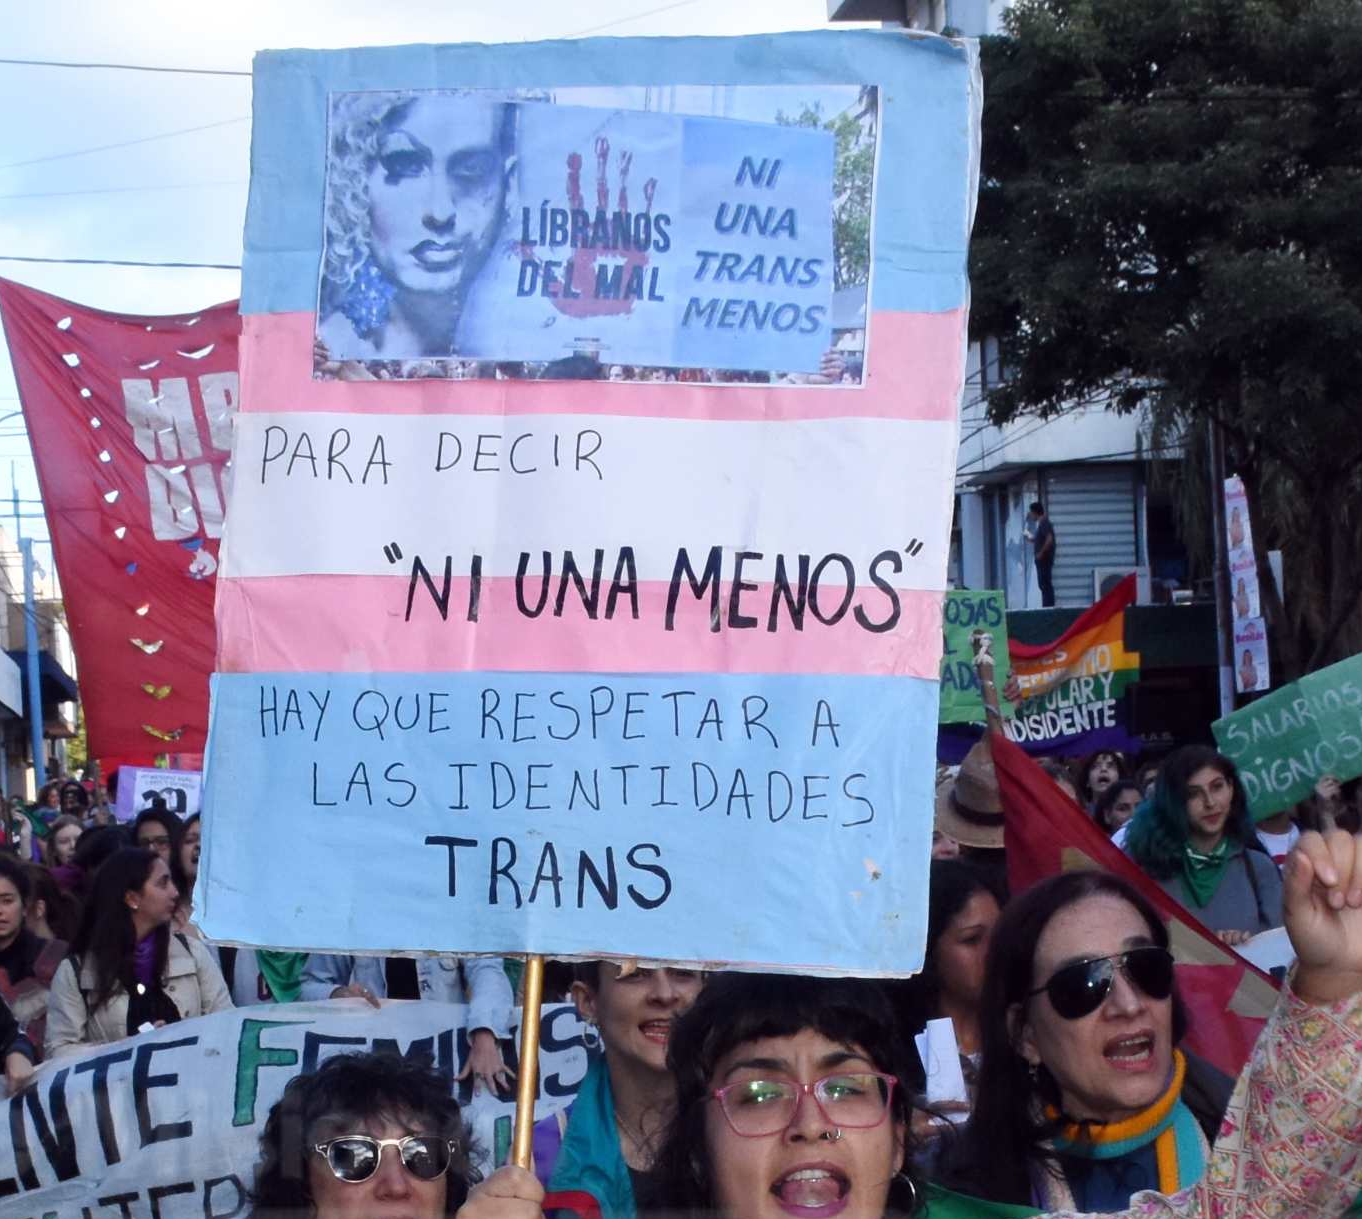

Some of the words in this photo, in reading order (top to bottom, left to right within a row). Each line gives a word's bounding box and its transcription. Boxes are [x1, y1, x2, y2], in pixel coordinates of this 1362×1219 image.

[735, 155, 783, 188] NI
[521, 203, 671, 254] LÍBRANOS
[713, 203, 798, 241] UNA
[517, 259, 581, 298] DEL
[595, 263, 664, 302] MAL
[693, 250, 822, 289] TRANS
[681, 298, 826, 335] MENOS
[261, 424, 393, 484] PARA
[436, 429, 604, 480] DECIR
[383, 542, 480, 623] "NI
[515, 547, 641, 621] UNA
[665, 537, 924, 633] MENOS"
[259, 686, 331, 741] HAY
[353, 689, 452, 740] QUE
[481, 688, 778, 747] RESPETAR
[811, 700, 840, 748] A
[312, 761, 418, 808] LAS
[448, 762, 876, 828] IDENTIDADES
[424, 836, 673, 910] TRANS
